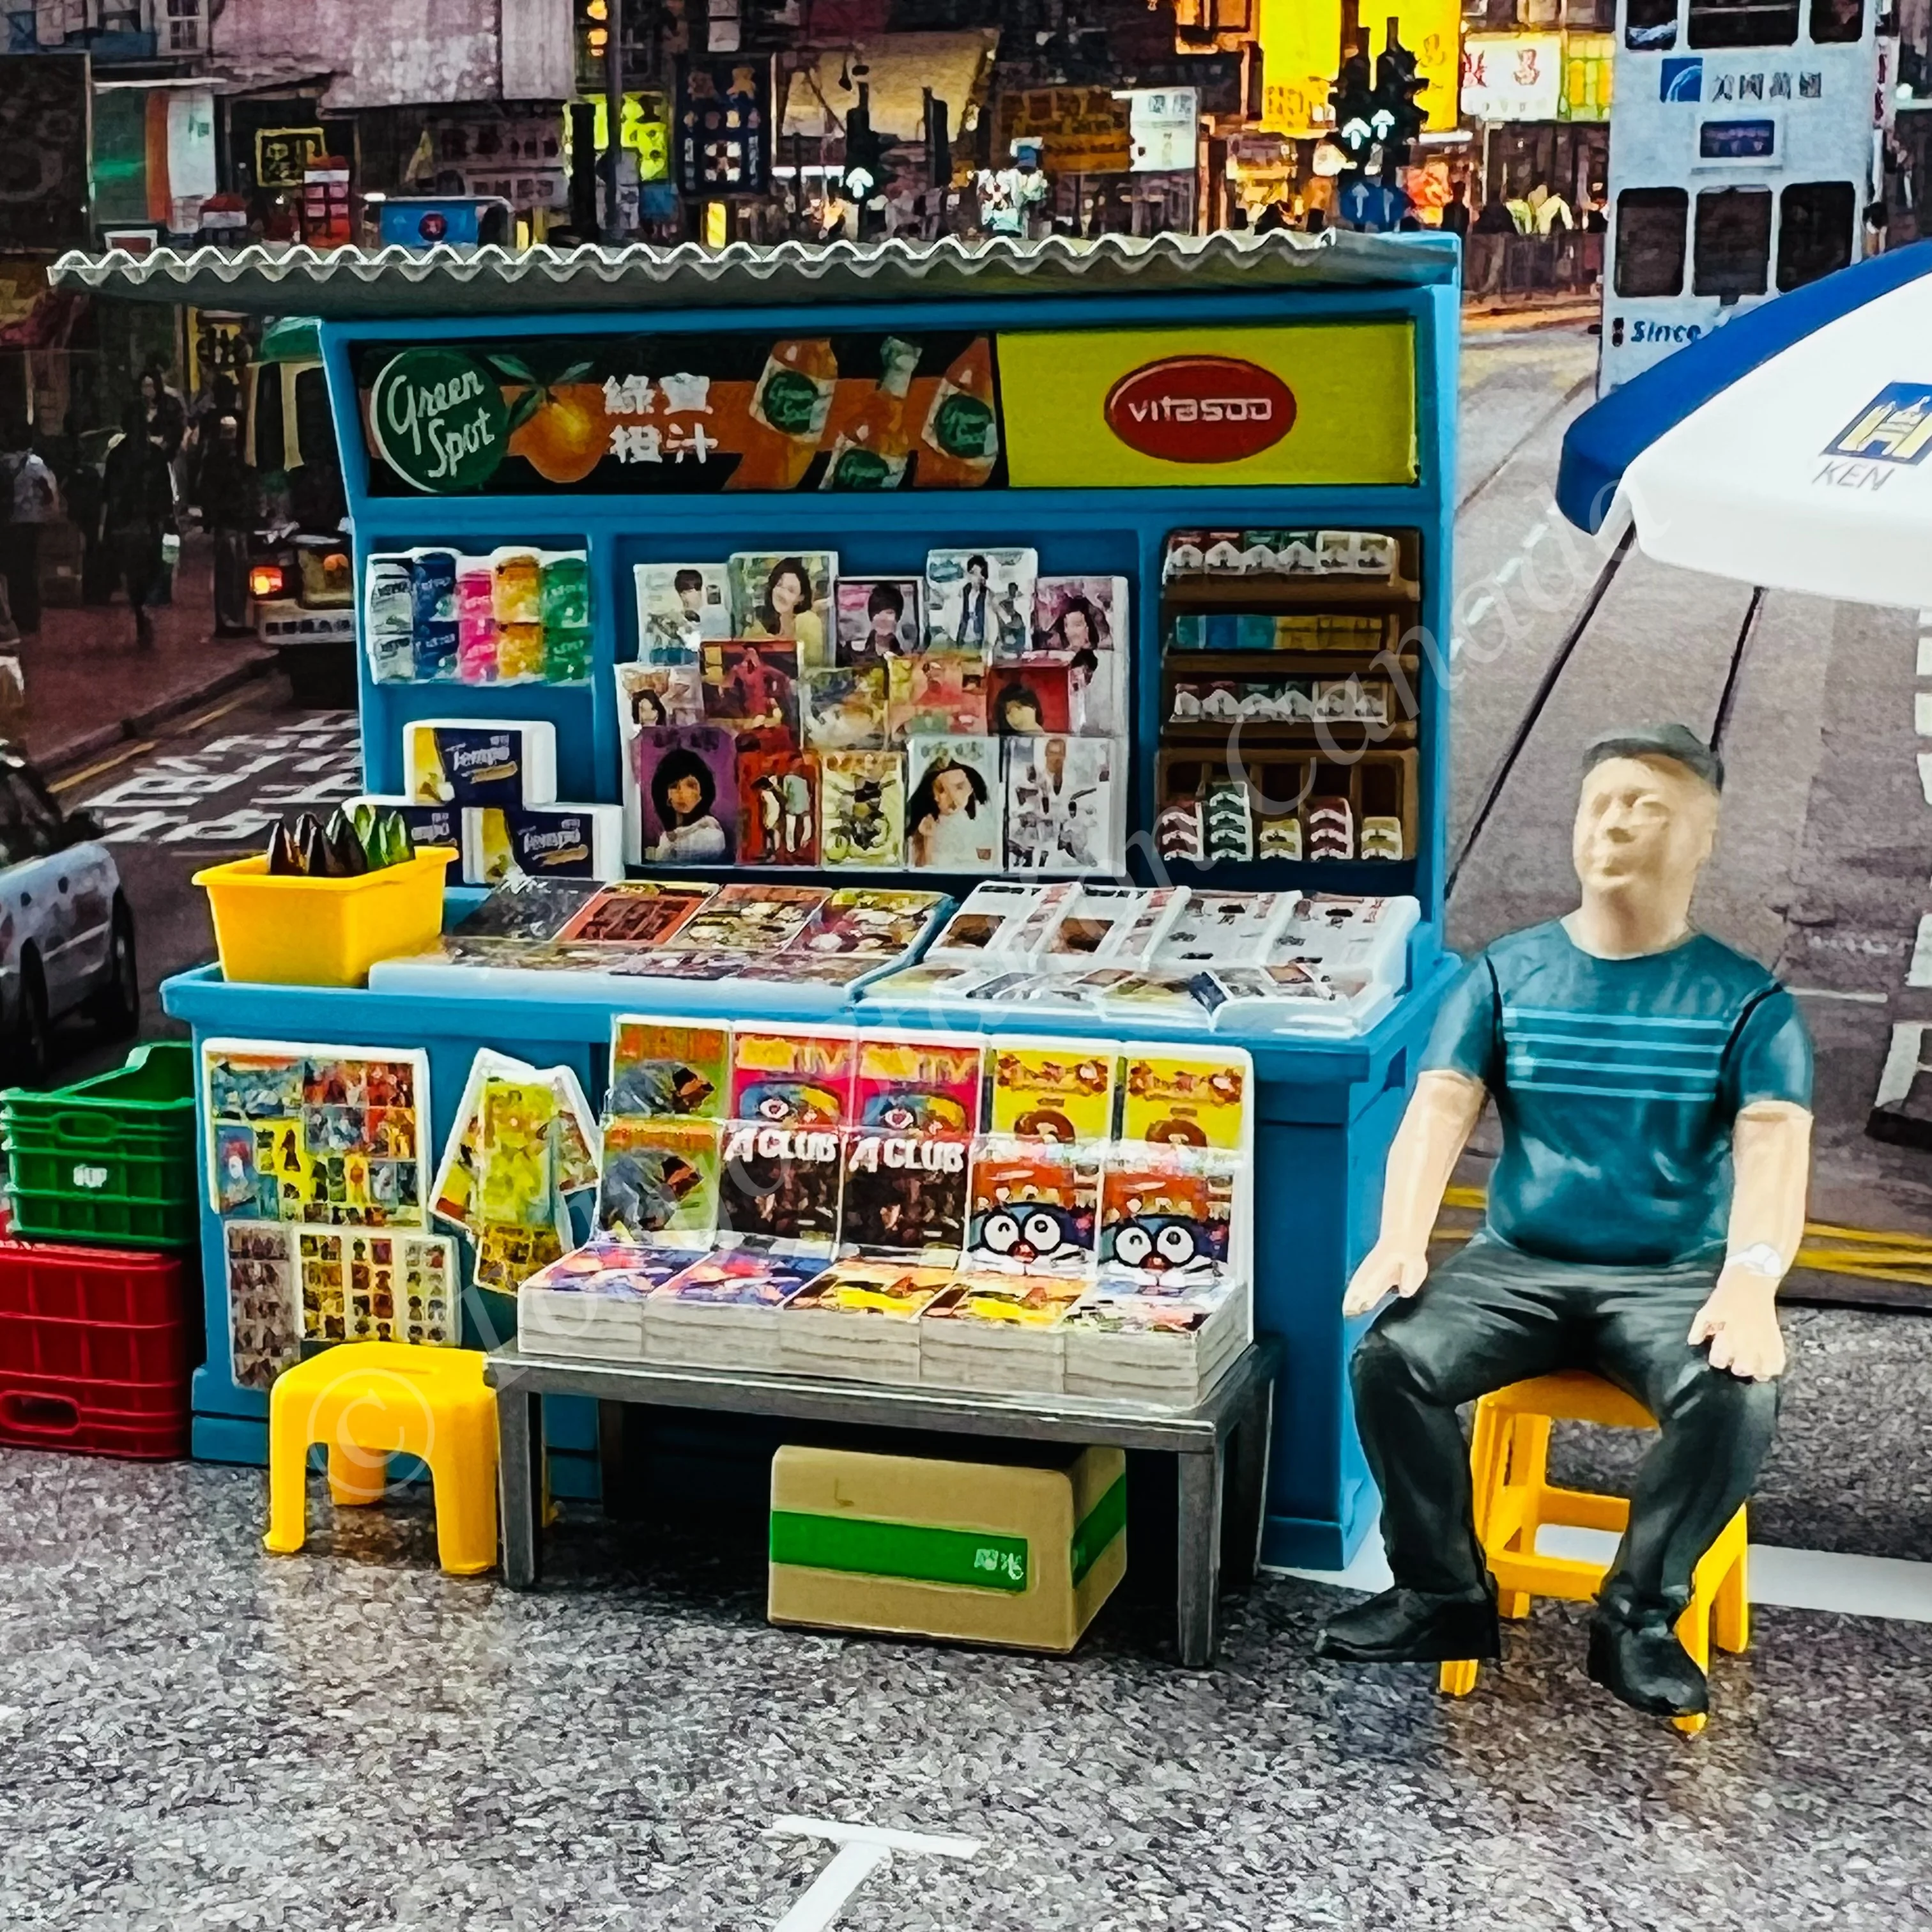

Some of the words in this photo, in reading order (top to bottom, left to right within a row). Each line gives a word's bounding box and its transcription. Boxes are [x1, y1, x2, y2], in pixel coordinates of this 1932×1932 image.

[387, 371, 484, 456] Green
[426, 407, 495, 478] Spot
[1811, 461, 1896, 491] KEN
[883, 1138, 965, 1174] CLUB
